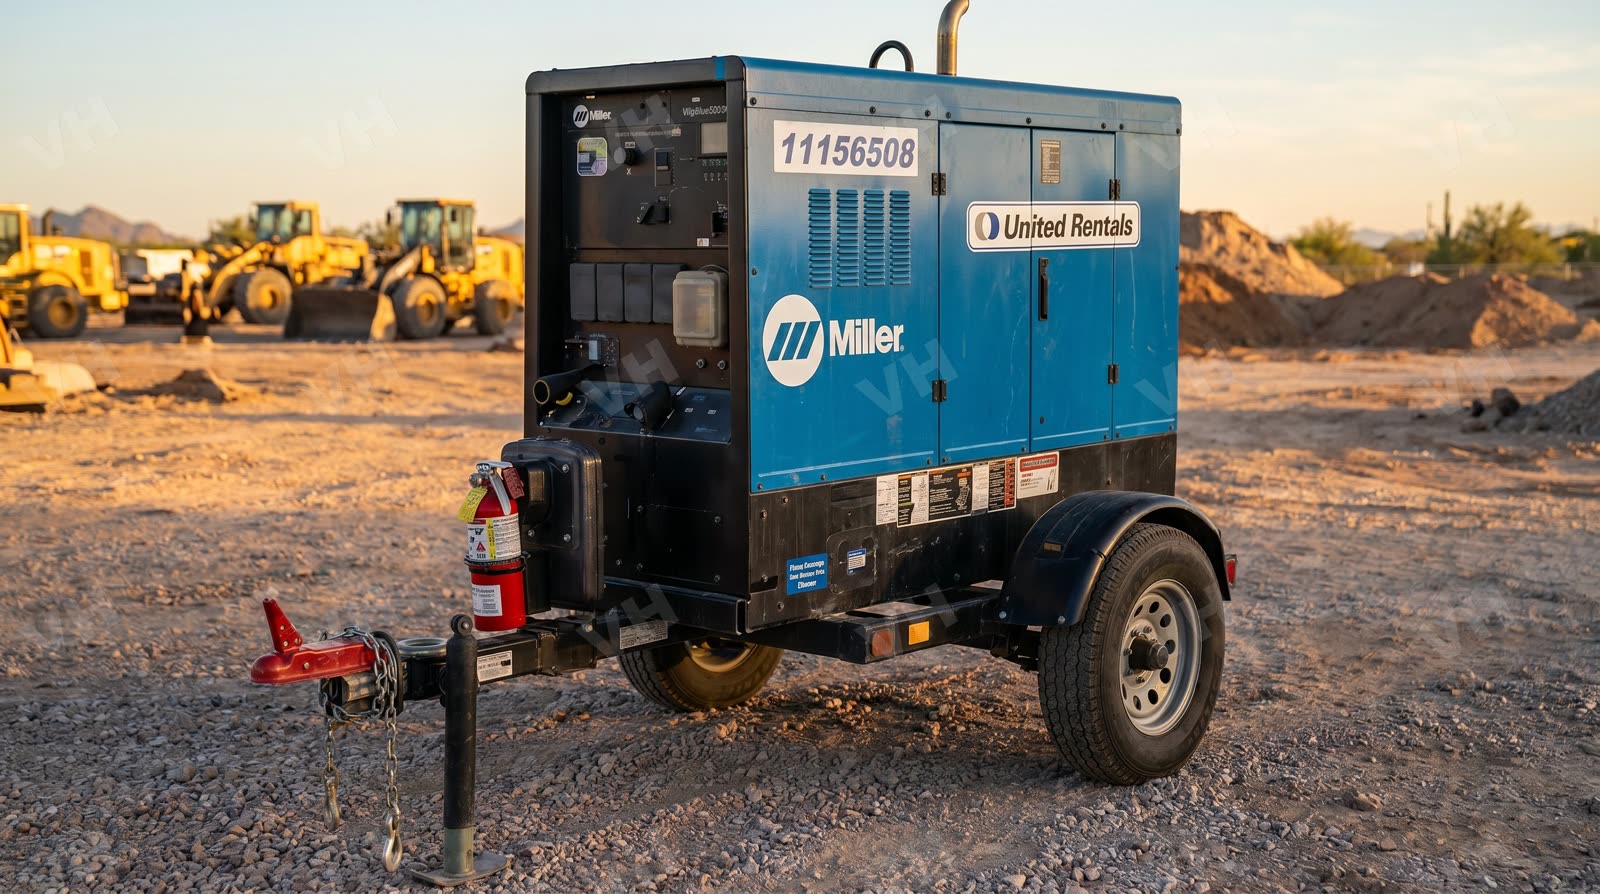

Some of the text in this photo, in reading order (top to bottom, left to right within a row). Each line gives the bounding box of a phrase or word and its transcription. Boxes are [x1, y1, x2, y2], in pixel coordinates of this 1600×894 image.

[589, 110, 611, 121] Miller
[781, 132, 916, 169] 11156508
[1004, 213, 1133, 239] United Rentals
